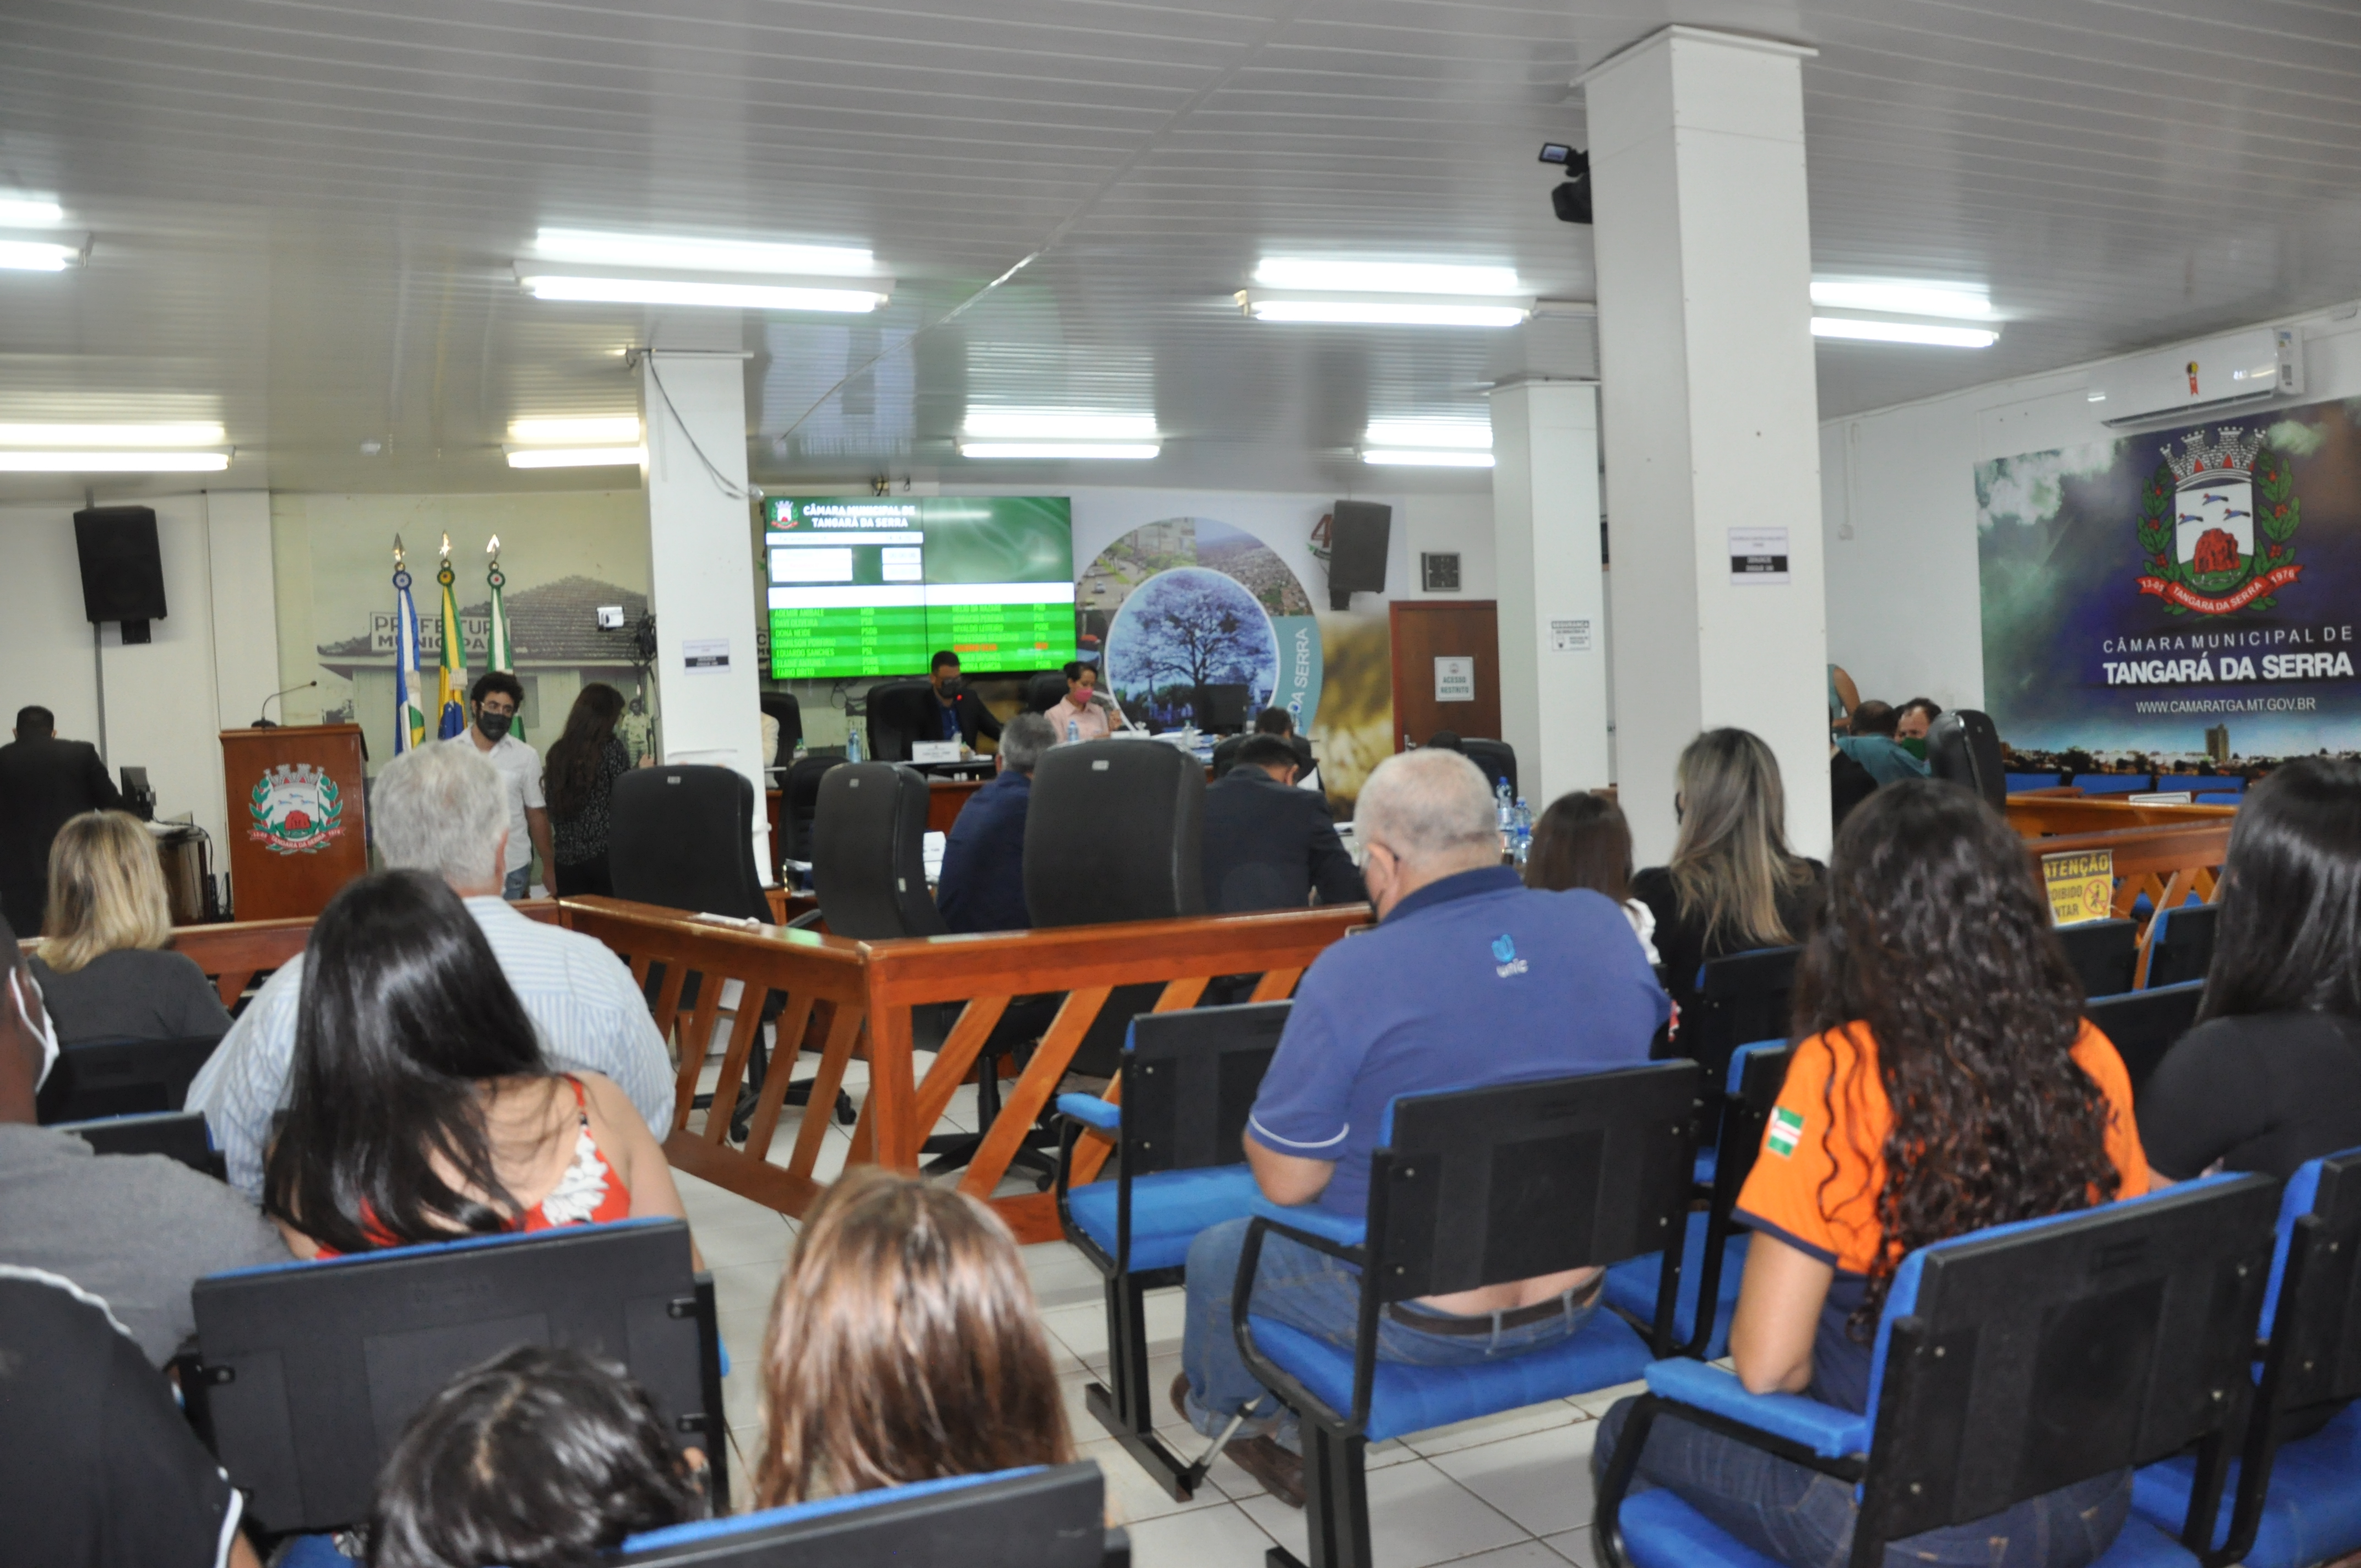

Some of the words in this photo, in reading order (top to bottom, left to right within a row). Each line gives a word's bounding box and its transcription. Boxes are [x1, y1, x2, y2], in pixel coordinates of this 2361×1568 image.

[803, 503, 846, 516] CÂMARA
[847, 505, 900, 516] MUNICIPAL
[902, 505, 915, 516] DE
[860, 518, 874, 528] DA
[875, 518, 909, 528] SERRA
[2216, 600, 2230, 611] DA
[2230, 581, 2263, 607] SERRA
[2270, 569, 2295, 584] 1976
[2103, 636, 2185, 654] CÂMARA
[2191, 628, 2314, 649] MUNICIPAL
[2324, 625, 2353, 642] DE
[1294, 627, 1310, 688] SERRA
[2103, 652, 2215, 684] TANGARÁ
[2221, 656, 2256, 681] DA
[2262, 651, 2354, 680] SERRA
[2136, 697, 2316, 714] WWW.CAMARATGA.MT.GOV.BR
[1496, 957, 1528, 978] unic
